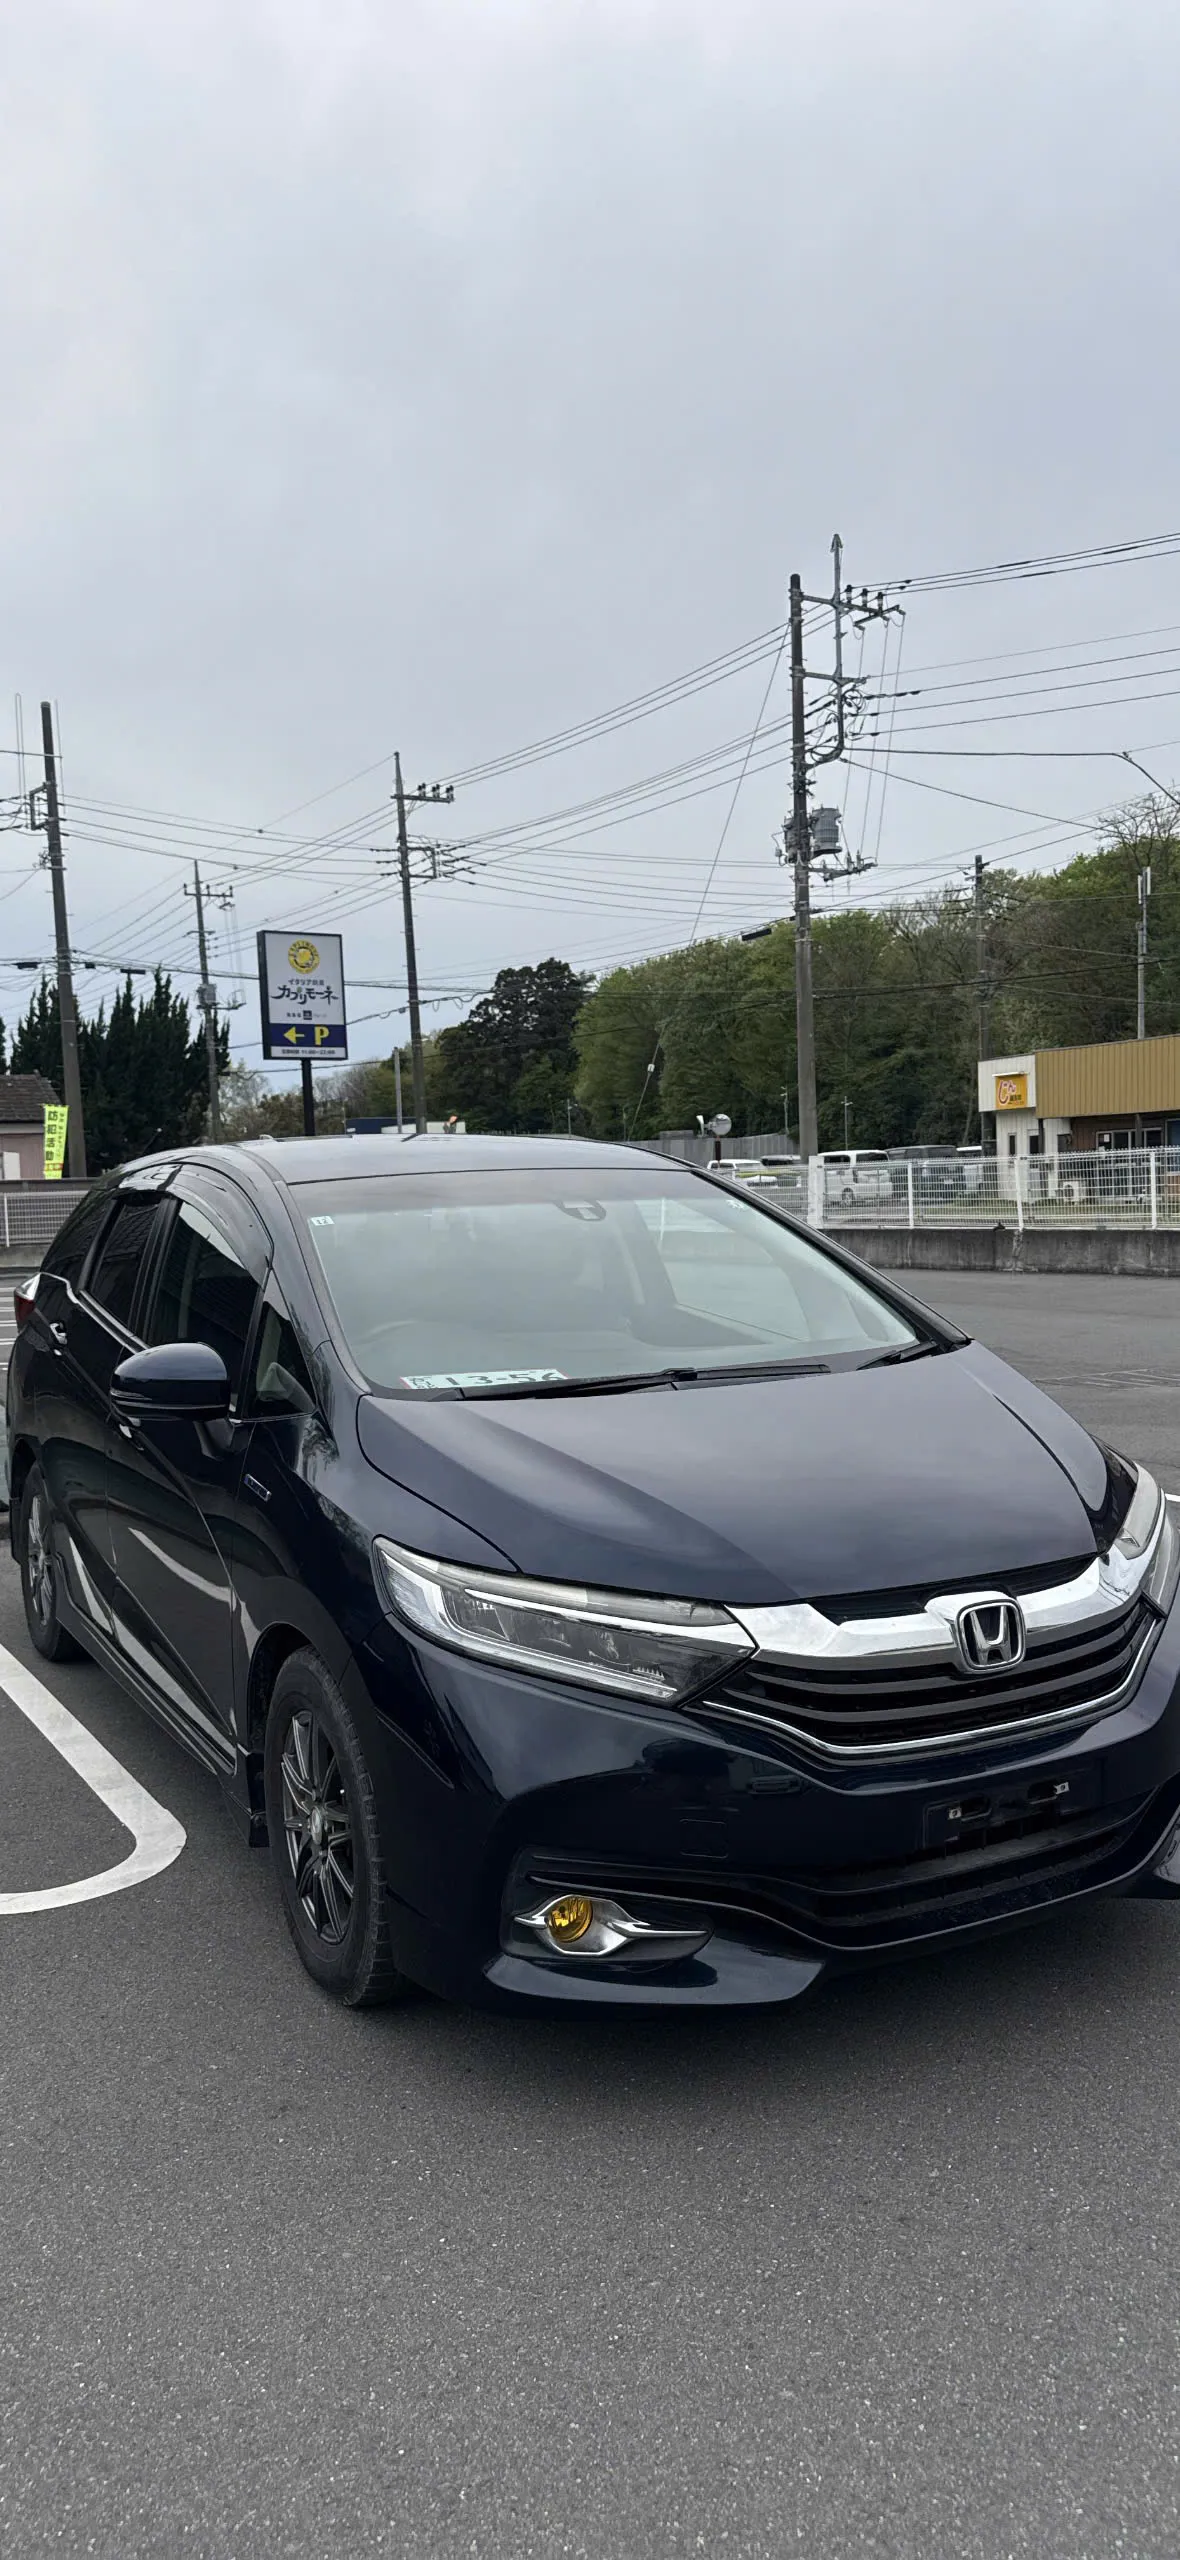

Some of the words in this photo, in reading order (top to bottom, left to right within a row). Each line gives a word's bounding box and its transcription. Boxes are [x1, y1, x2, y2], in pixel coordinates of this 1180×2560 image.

[271, 985, 339, 1005] カプリモーネ
[315, 1026, 329, 1045] P
[446, 1372, 564, 1386] 13-56
